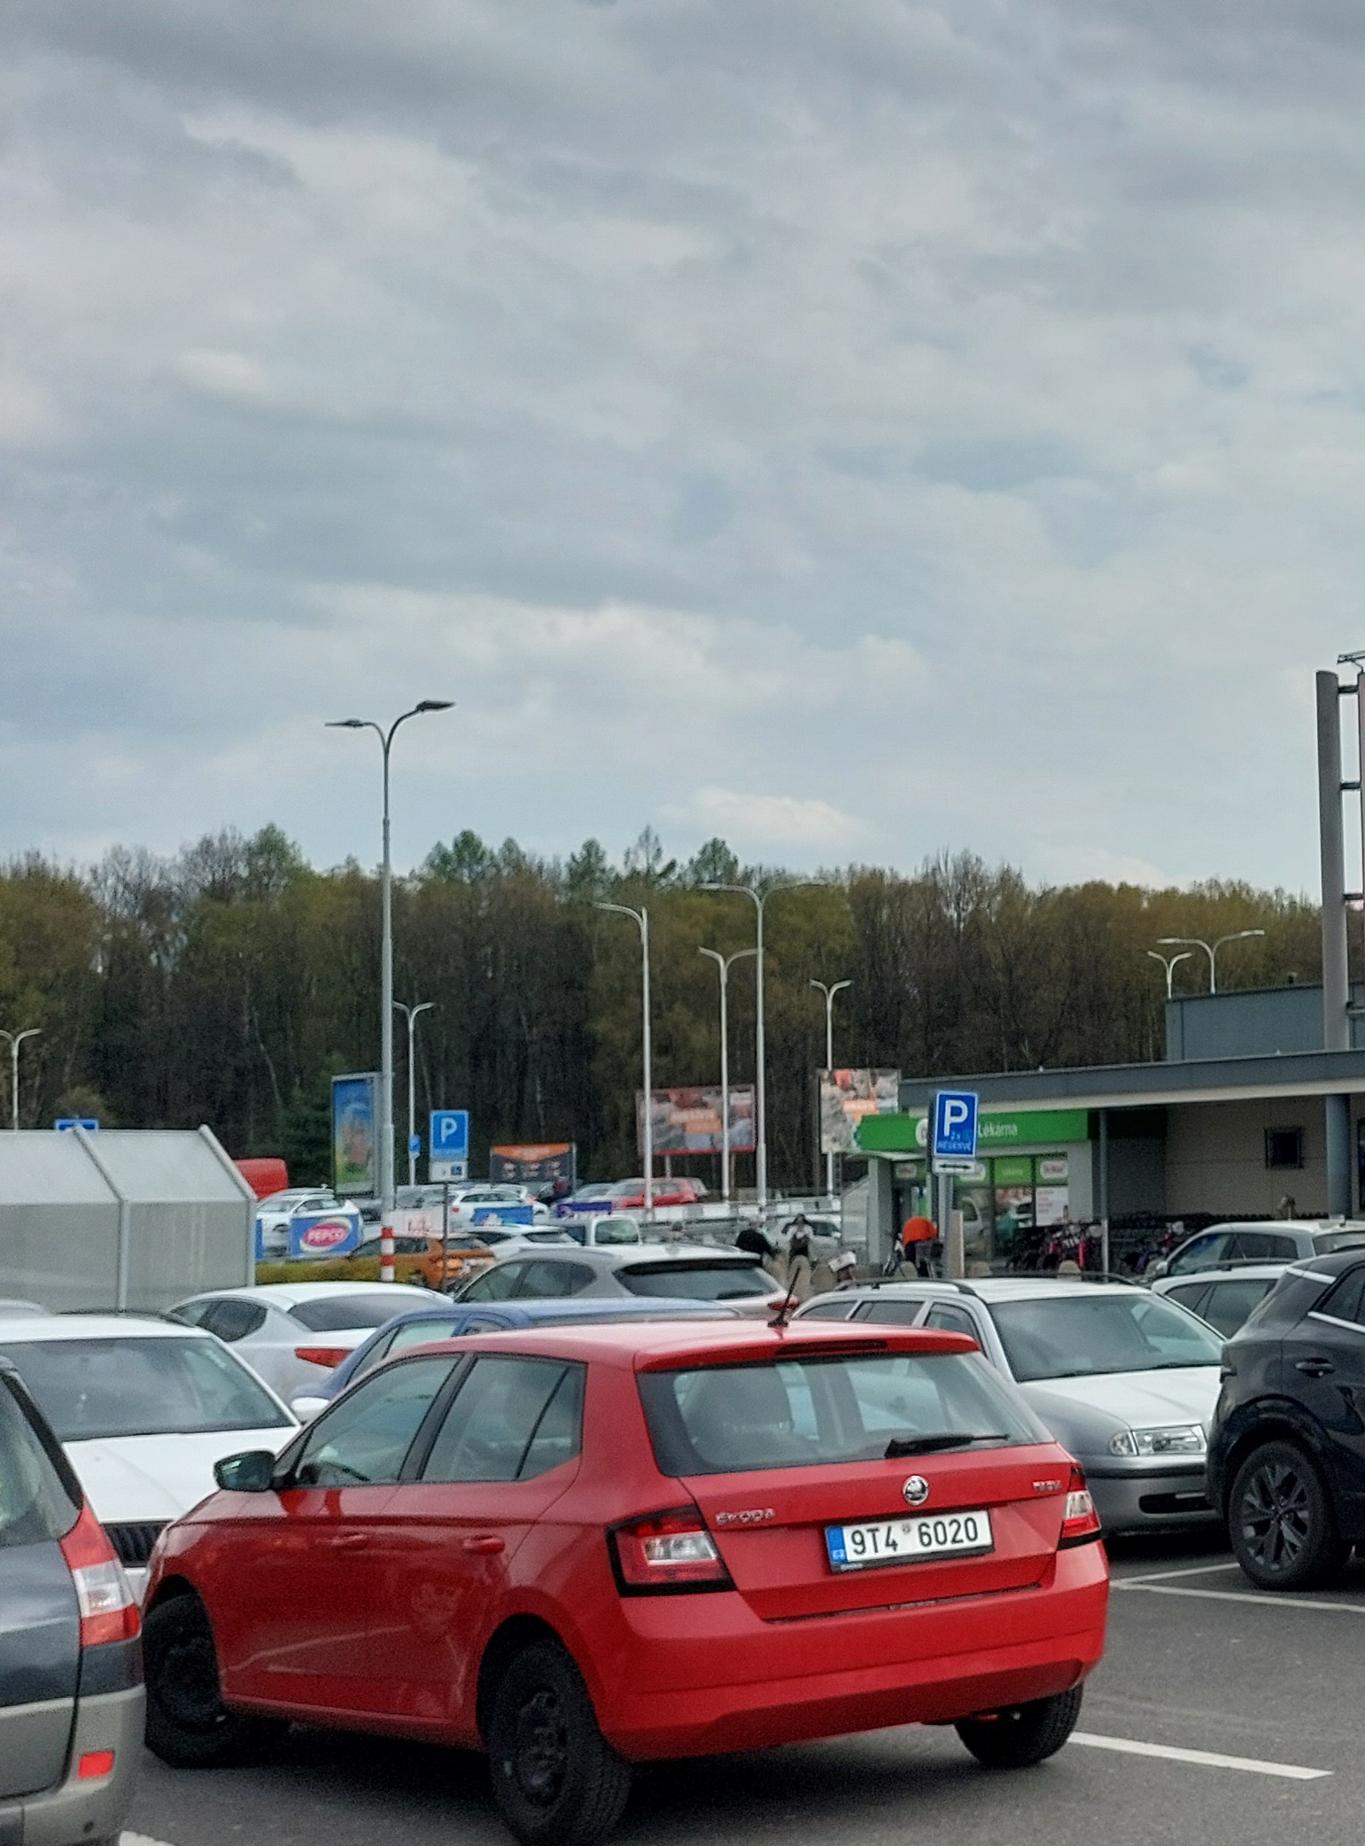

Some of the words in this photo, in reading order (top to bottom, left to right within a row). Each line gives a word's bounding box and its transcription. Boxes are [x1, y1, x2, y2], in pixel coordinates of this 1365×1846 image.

[440, 1117, 458, 1144] P
[943, 1099, 969, 1137] P
[851, 1524, 899, 1556] 9T4
[917, 1516, 979, 1548] 6020
